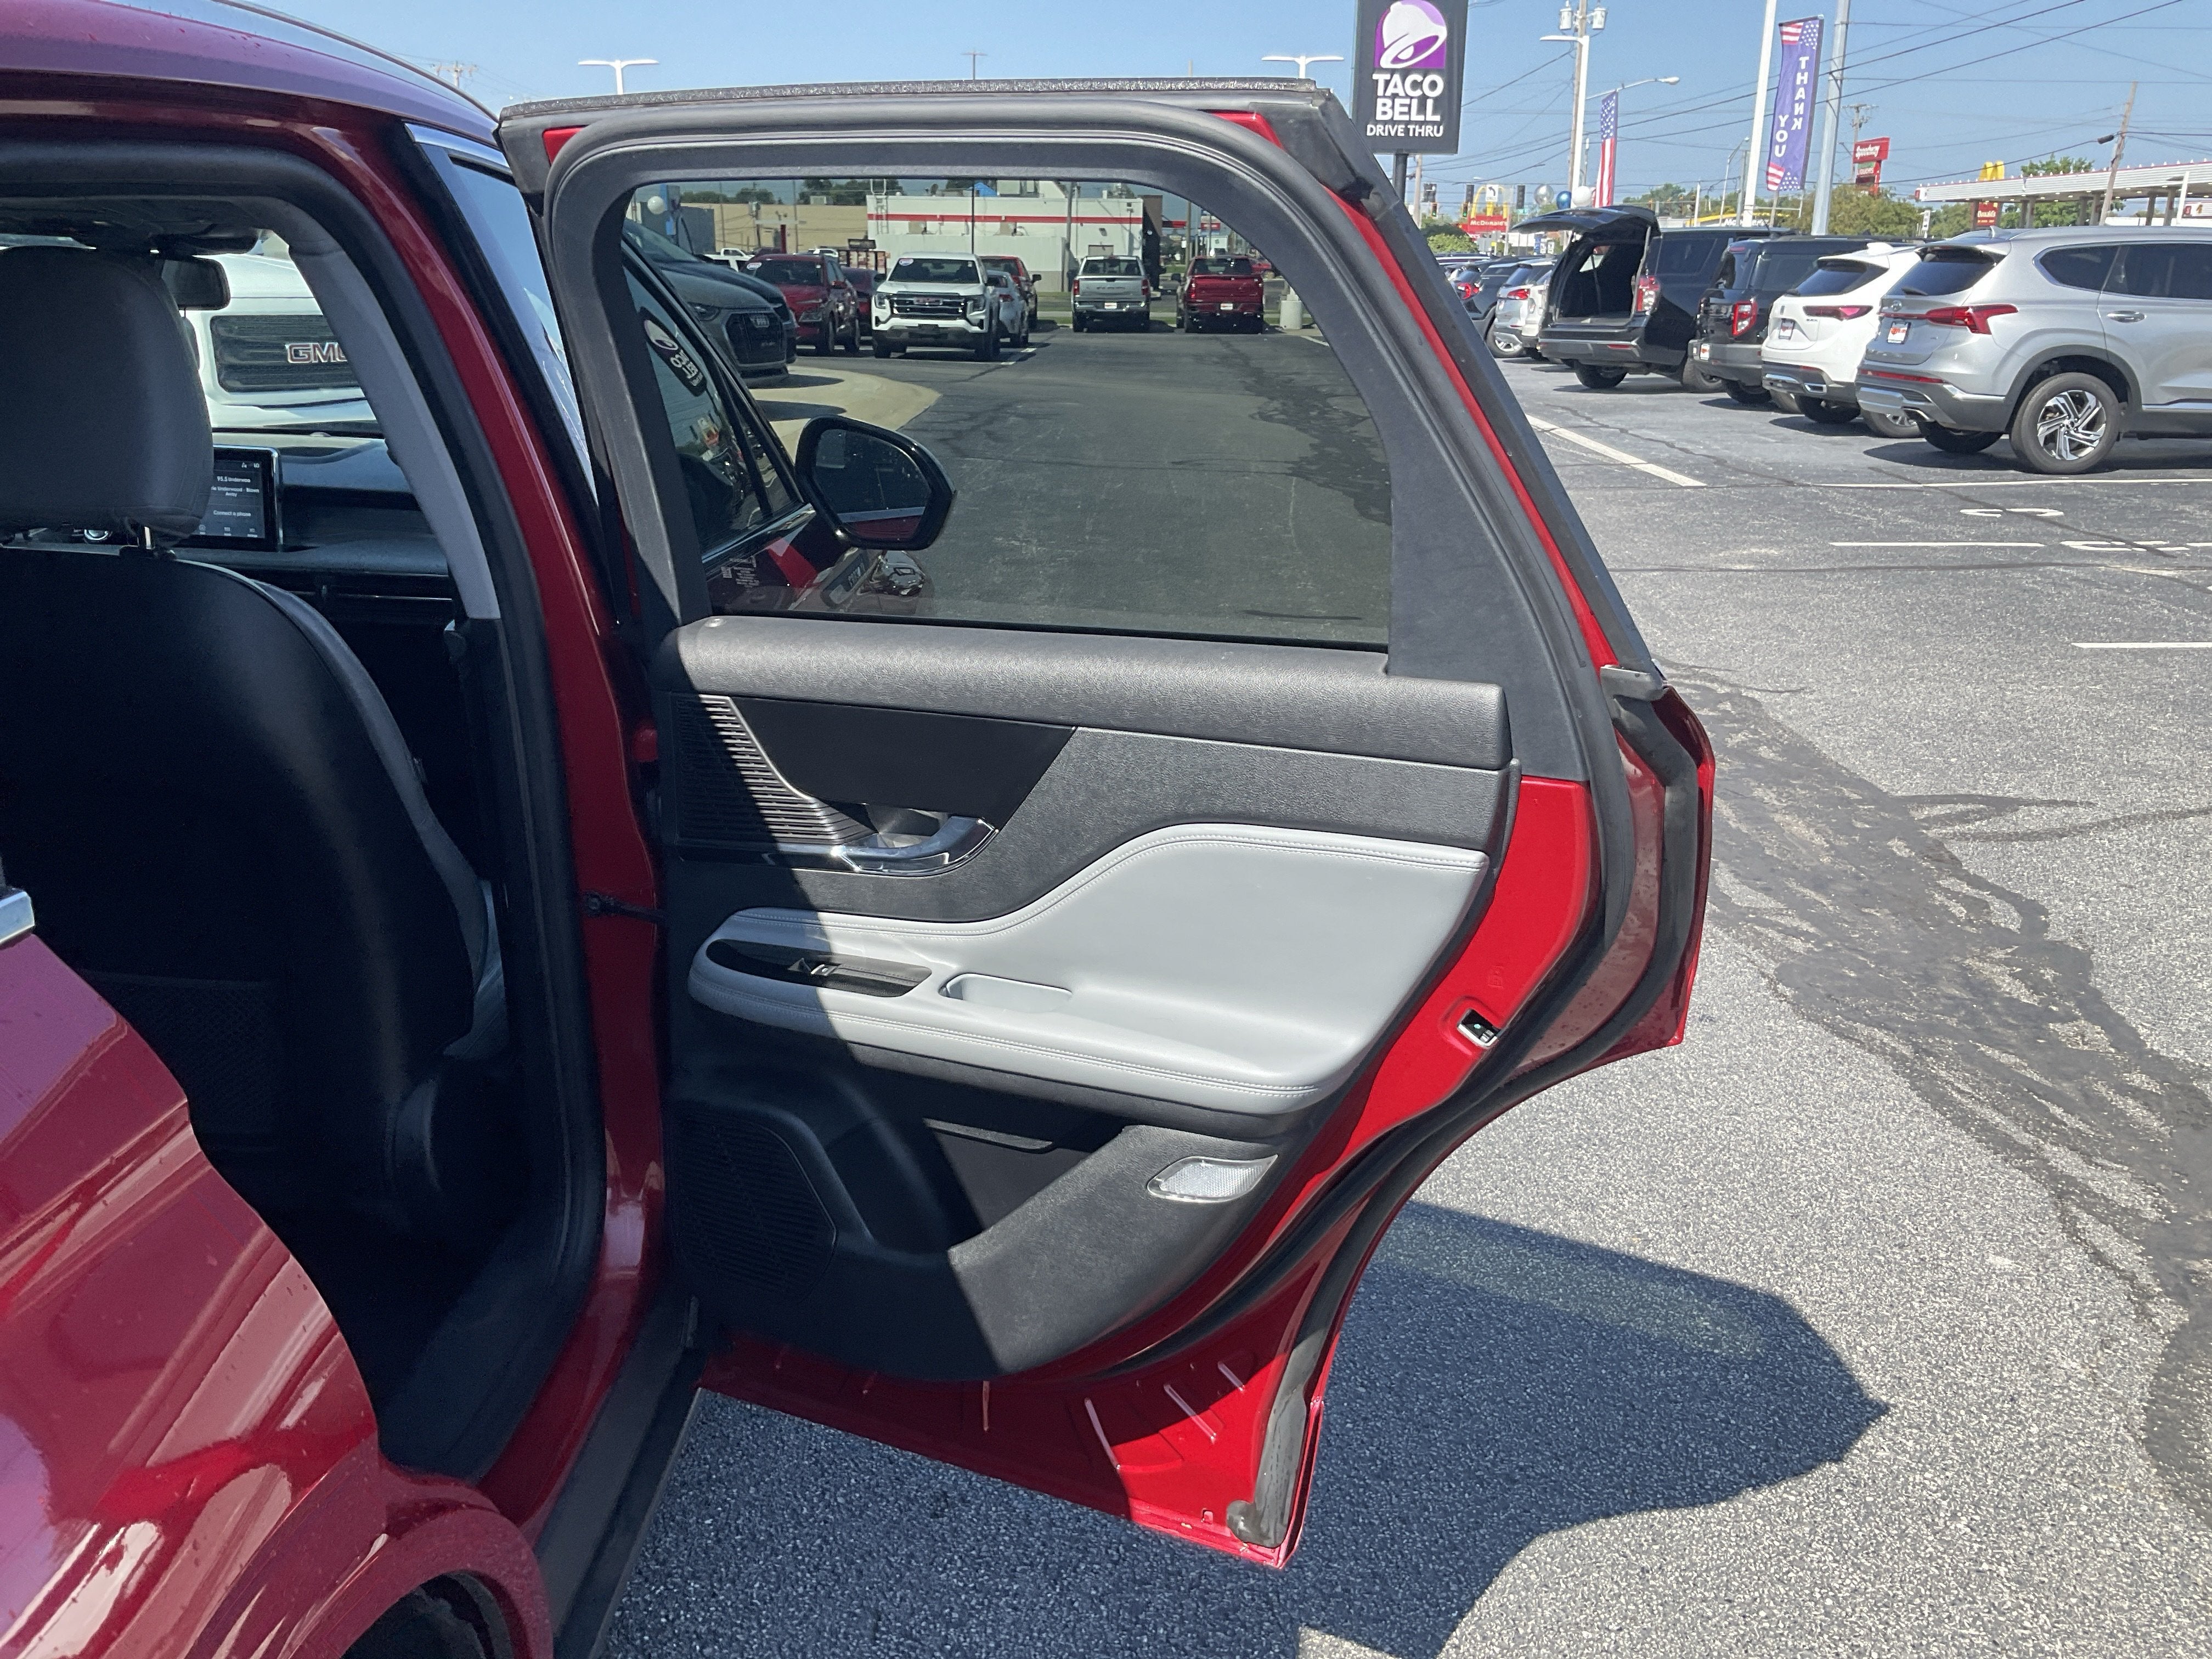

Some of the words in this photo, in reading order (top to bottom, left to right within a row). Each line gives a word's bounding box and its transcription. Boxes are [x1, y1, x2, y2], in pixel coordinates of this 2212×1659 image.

[1372, 74, 1444, 97] TACO
[1375, 98, 1441, 121] BELL
[1366, 124, 1405, 136] DRIVE
[1408, 125, 1443, 137] THRU
